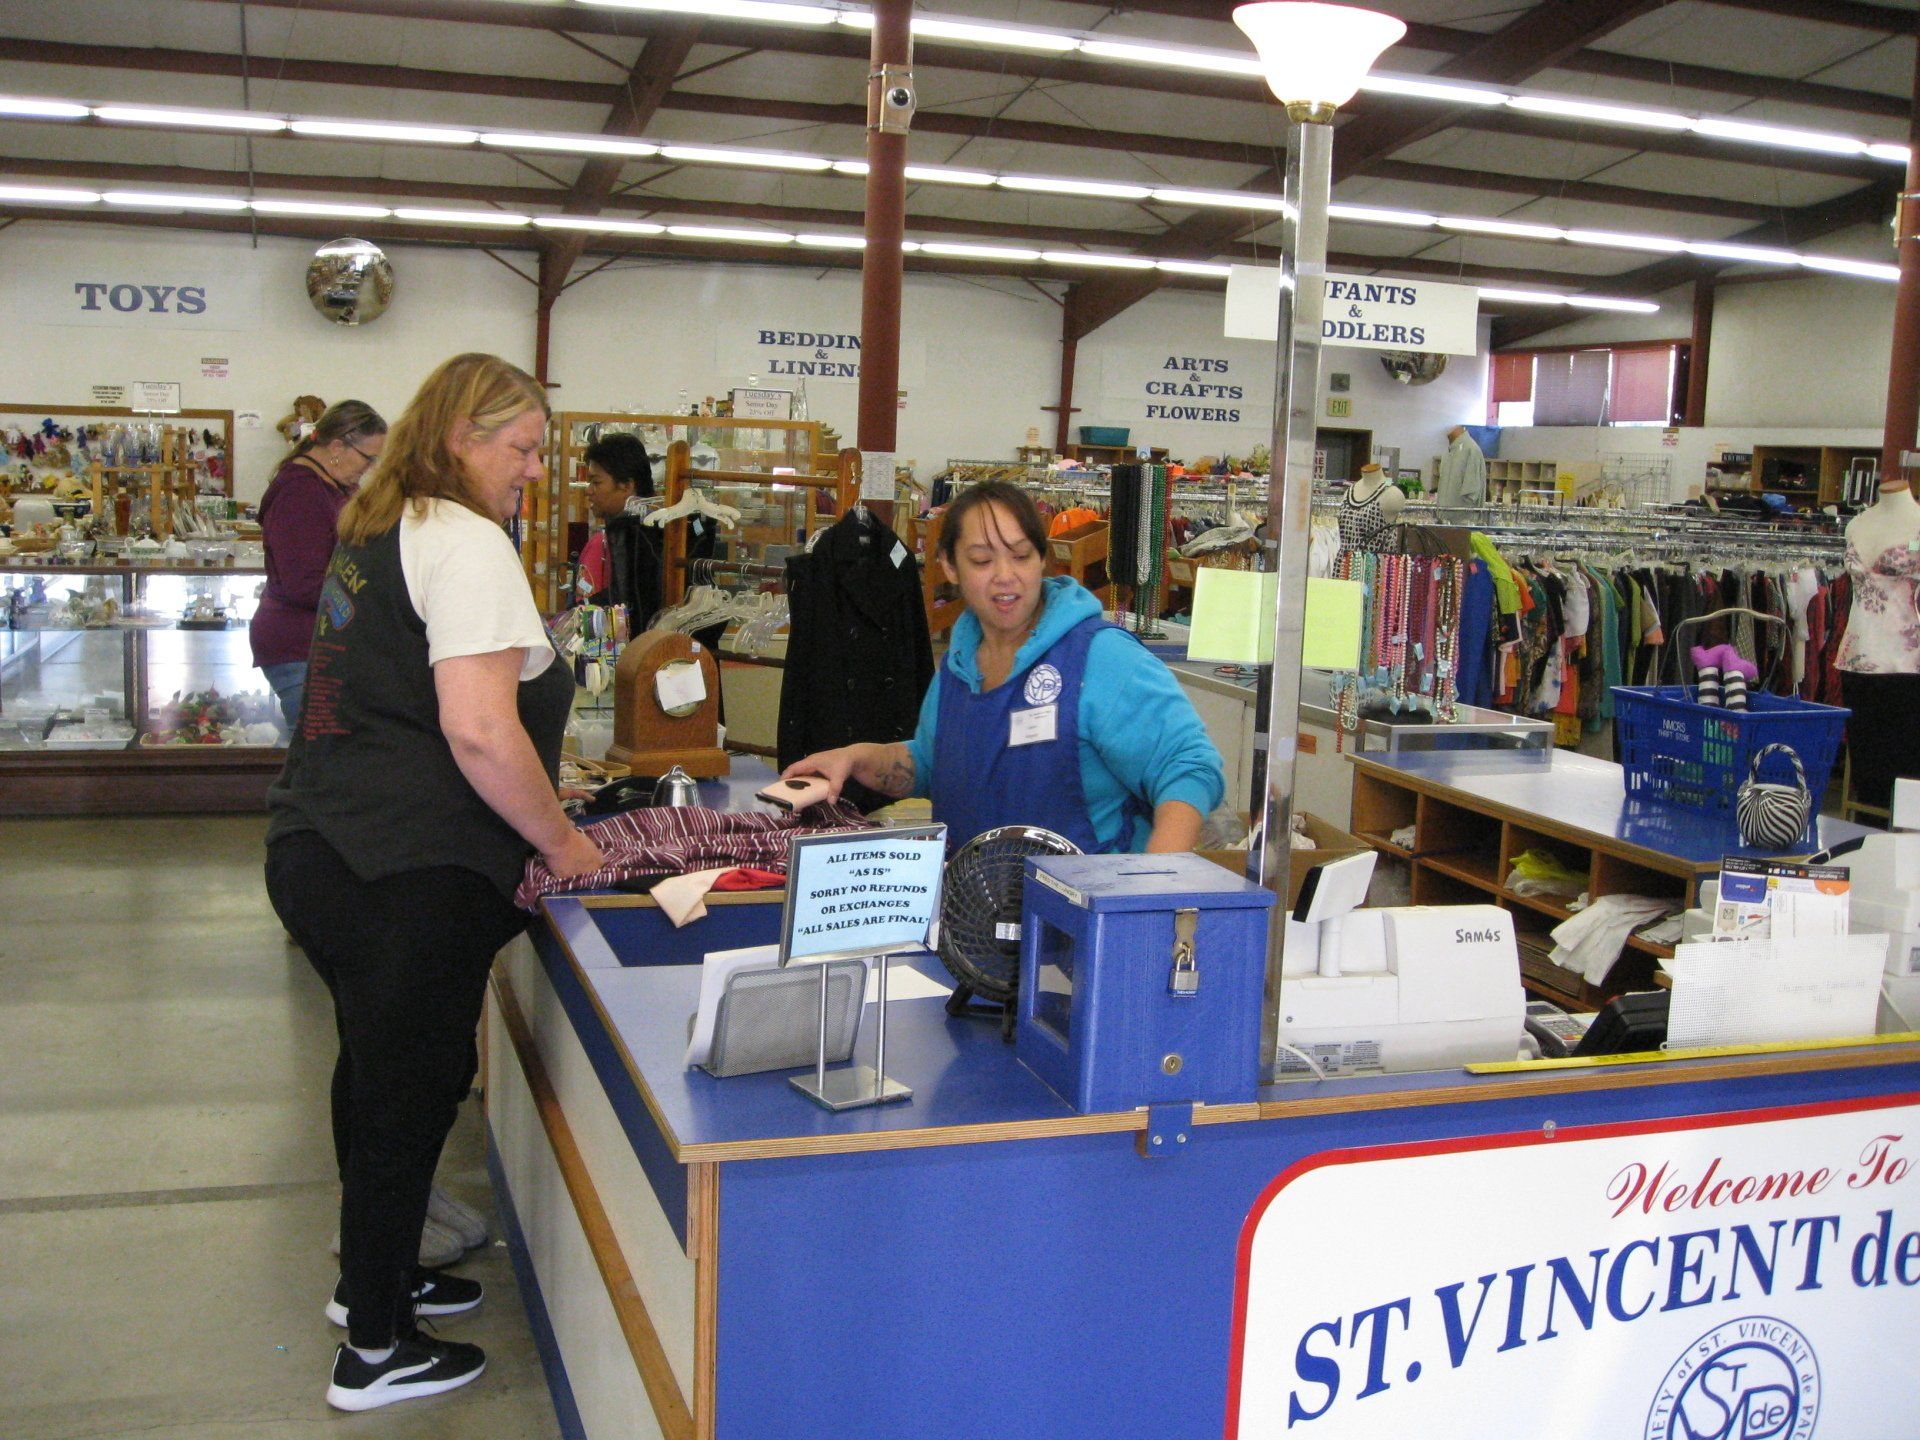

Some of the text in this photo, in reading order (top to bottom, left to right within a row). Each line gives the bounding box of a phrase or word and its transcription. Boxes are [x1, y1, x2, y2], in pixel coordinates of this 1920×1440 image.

[75, 283, 206, 314] TOYS
[1324, 280, 1416, 305] FANTS
[1348, 304, 1362, 318] &
[758, 330, 861, 349] BEDDIN
[1322, 320, 1425, 345] DDLERS
[815, 349, 828, 360] &
[1163, 357, 1228, 373] ARTS
[1189, 373, 1201, 382] &
[744, 390, 782, 399] Tuesdays
[1146, 381, 1243, 399] CRAFTS
[1146, 404, 1240, 422] FLOWERS
[1332, 400, 1347, 414] EXIT
[1662, 719, 1686, 733] NMCRS
[1676, 733, 1691, 743] STORE
[827, 851, 921, 864] ALL ITEMS SOLD
[849, 868, 891, 877] “AS IS”
[810, 884, 928, 899] SORRY NO REFUNDS
[820, 900, 910, 915] OR EXCHANGES
[798, 926, 824, 936] “ALL
[826, 918, 860, 931] SALES
[862, 915, 885, 926] ARE
[1456, 928, 1501, 943] SAM4S
[1606, 1134, 1920, 1219] Welcome To
[1434, 1214, 1840, 1369] VINCENT
[1851, 1209, 1920, 1288] de
[1677, 1359, 1694, 1379] of
[1700, 1333, 1727, 1358] ST.
[1738, 1322, 1809, 1365] VINCENT
[1801, 1374, 1813, 1393] de
[1749, 1402, 1785, 1430] de
